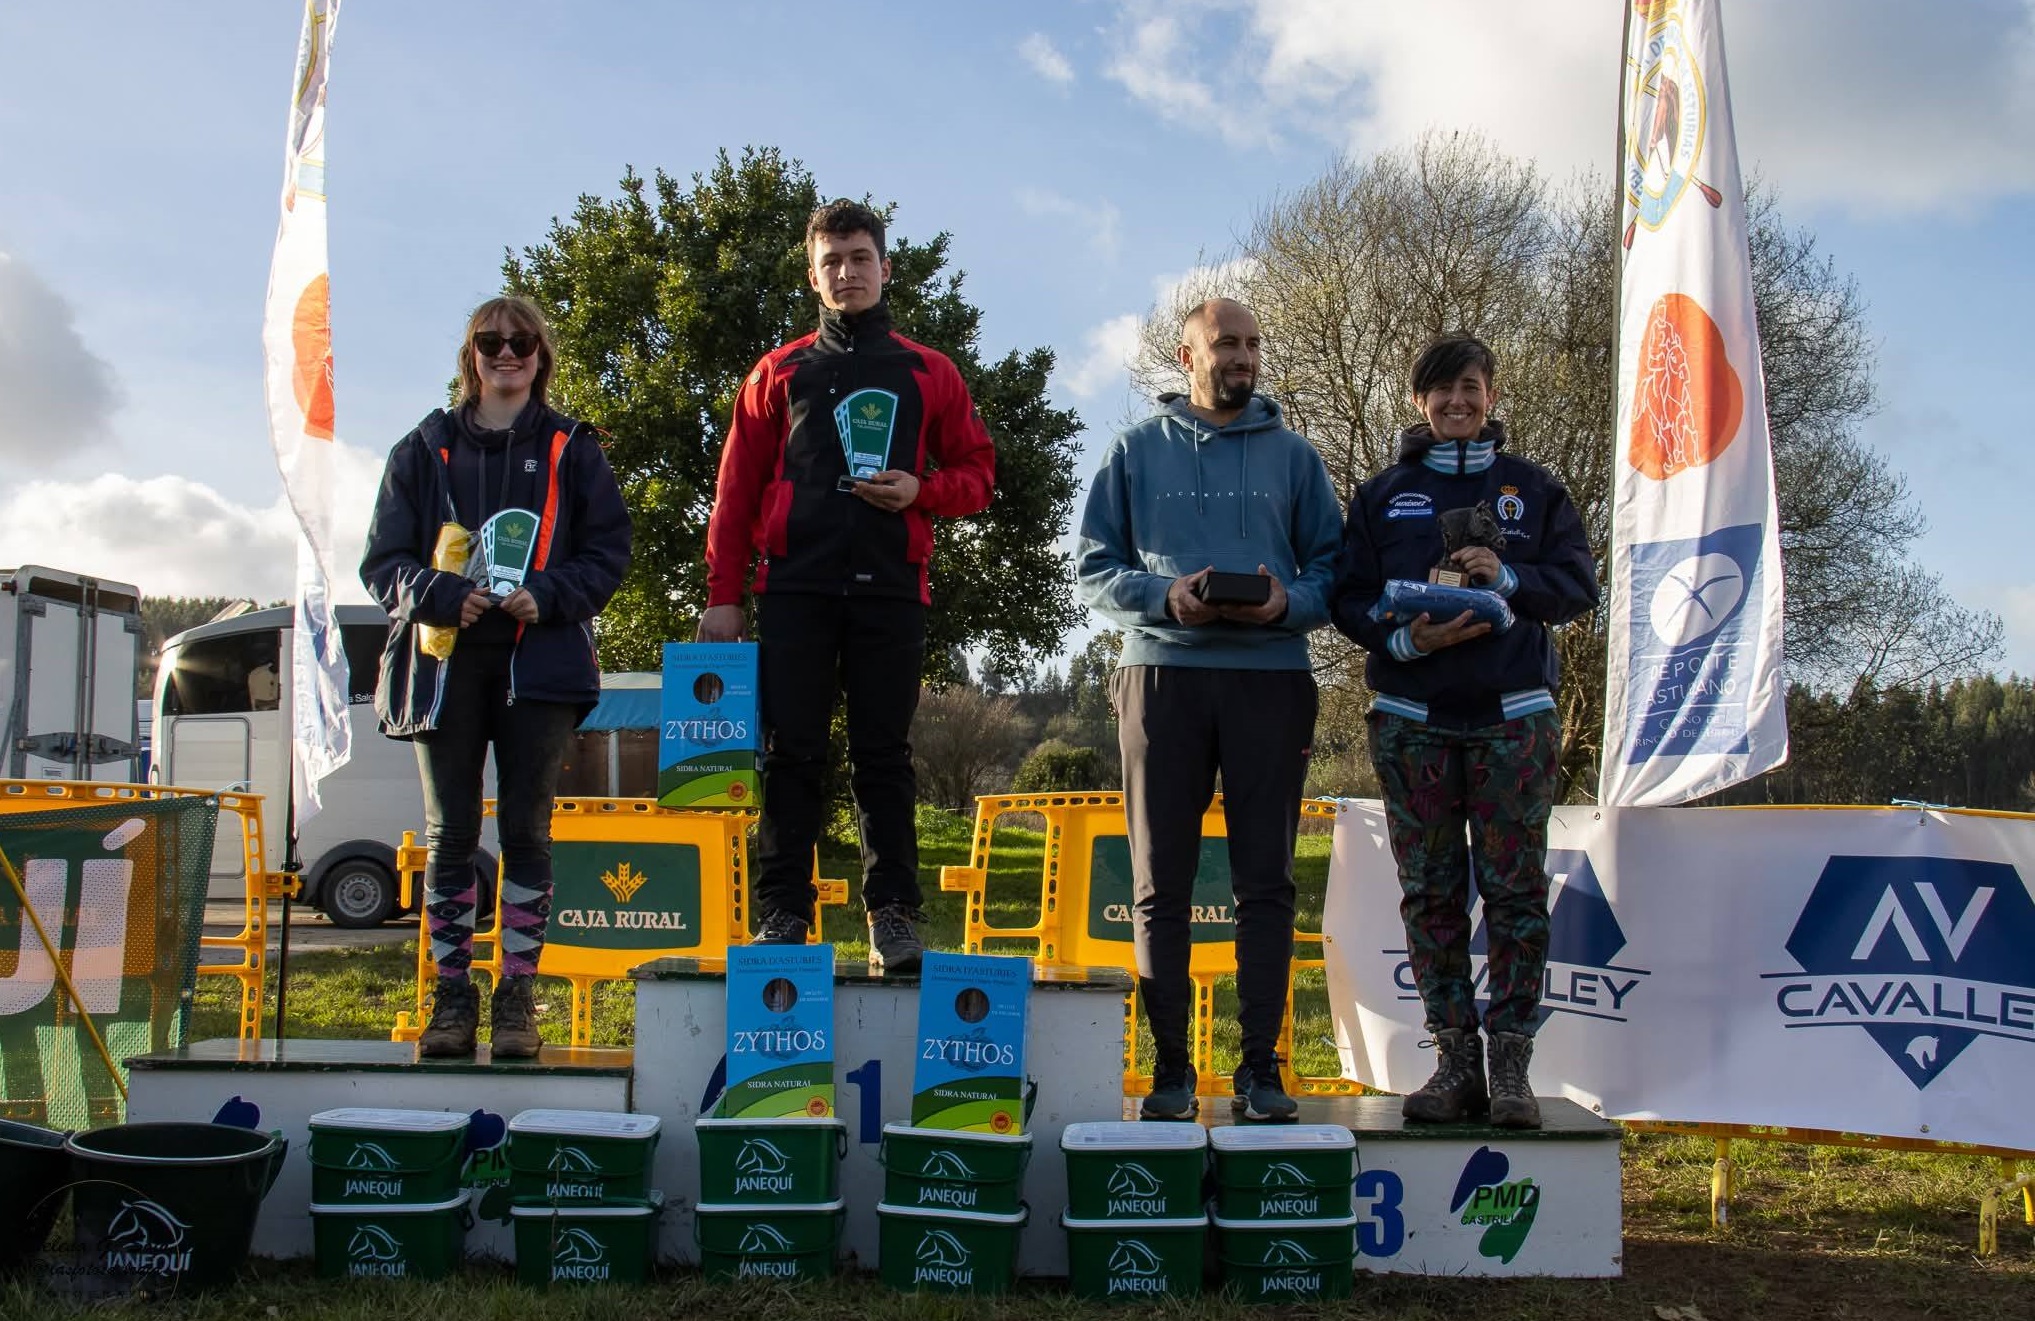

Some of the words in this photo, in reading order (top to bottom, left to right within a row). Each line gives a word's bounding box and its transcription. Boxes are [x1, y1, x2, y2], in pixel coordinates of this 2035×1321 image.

[665, 720, 747, 739] ZYTHOS
[558, 909, 611, 929] CAJA
[614, 910, 687, 929] RURAL
[1103, 904, 1133, 922] CA
[1191, 905, 1233, 923] RAL
[733, 1029, 826, 1053] ZYTHOS
[922, 1038, 1014, 1065] ZYTHOS
[747, 1080, 773, 1089] SIDRA
[933, 1089, 959, 1098] SIDRA
[846, 1060, 881, 1143] 1
[343, 1179, 403, 1199] JANEQUÍ
[734, 1172, 794, 1195] JANEQUÍ
[917, 1187, 978, 1208] JANEQUÍ
[1106, 1196, 1167, 1217] JANEQUÍ
[1259, 1195, 1319, 1217] JANEQUÍ
[1473, 1184, 1538, 1209] PMD
[1355, 1169, 1405, 1258] 3
[105, 1247, 194, 1277] JANEQUÍ
[552, 1262, 611, 1282] JANEQUÍ
[738, 1258, 798, 1279] JANEQUÍ
[912, 1267, 974, 1288] JANEQUÍ
[1107, 1275, 1168, 1295] JANEQUÍ
[1260, 1273, 1321, 1295] JANEQUÍ
